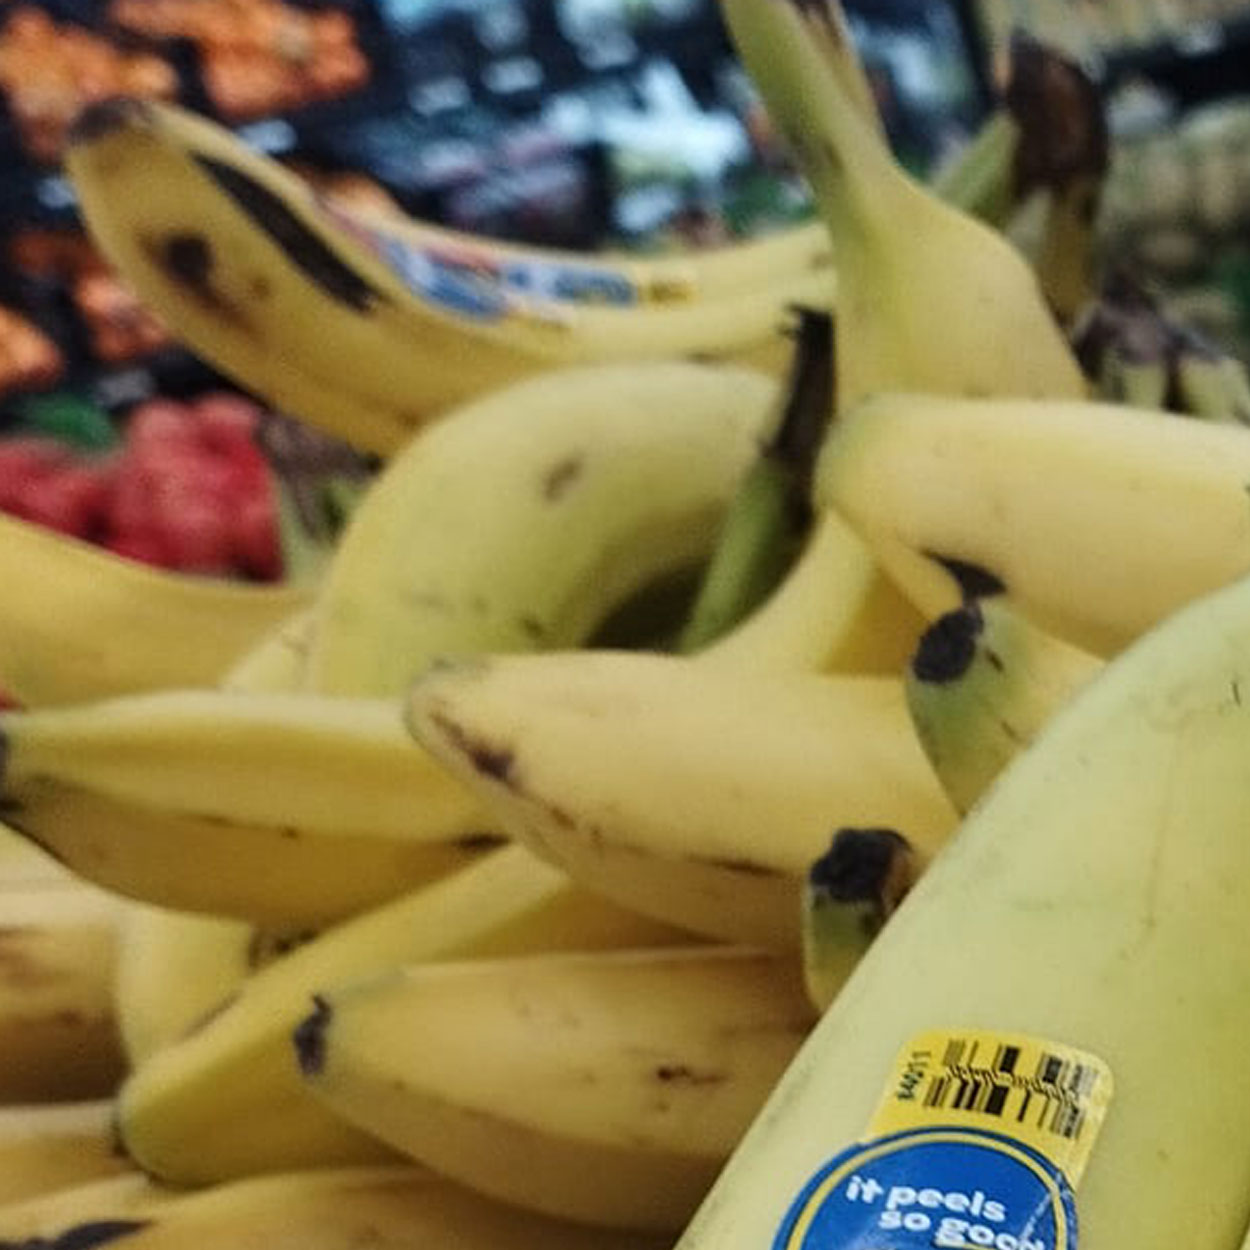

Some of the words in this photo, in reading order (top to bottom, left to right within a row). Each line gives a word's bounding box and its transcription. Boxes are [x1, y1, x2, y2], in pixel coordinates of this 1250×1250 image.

[846, 1175, 884, 1204] it
[886, 1186, 1007, 1223] peels
[878, 1210, 932, 1231] so
